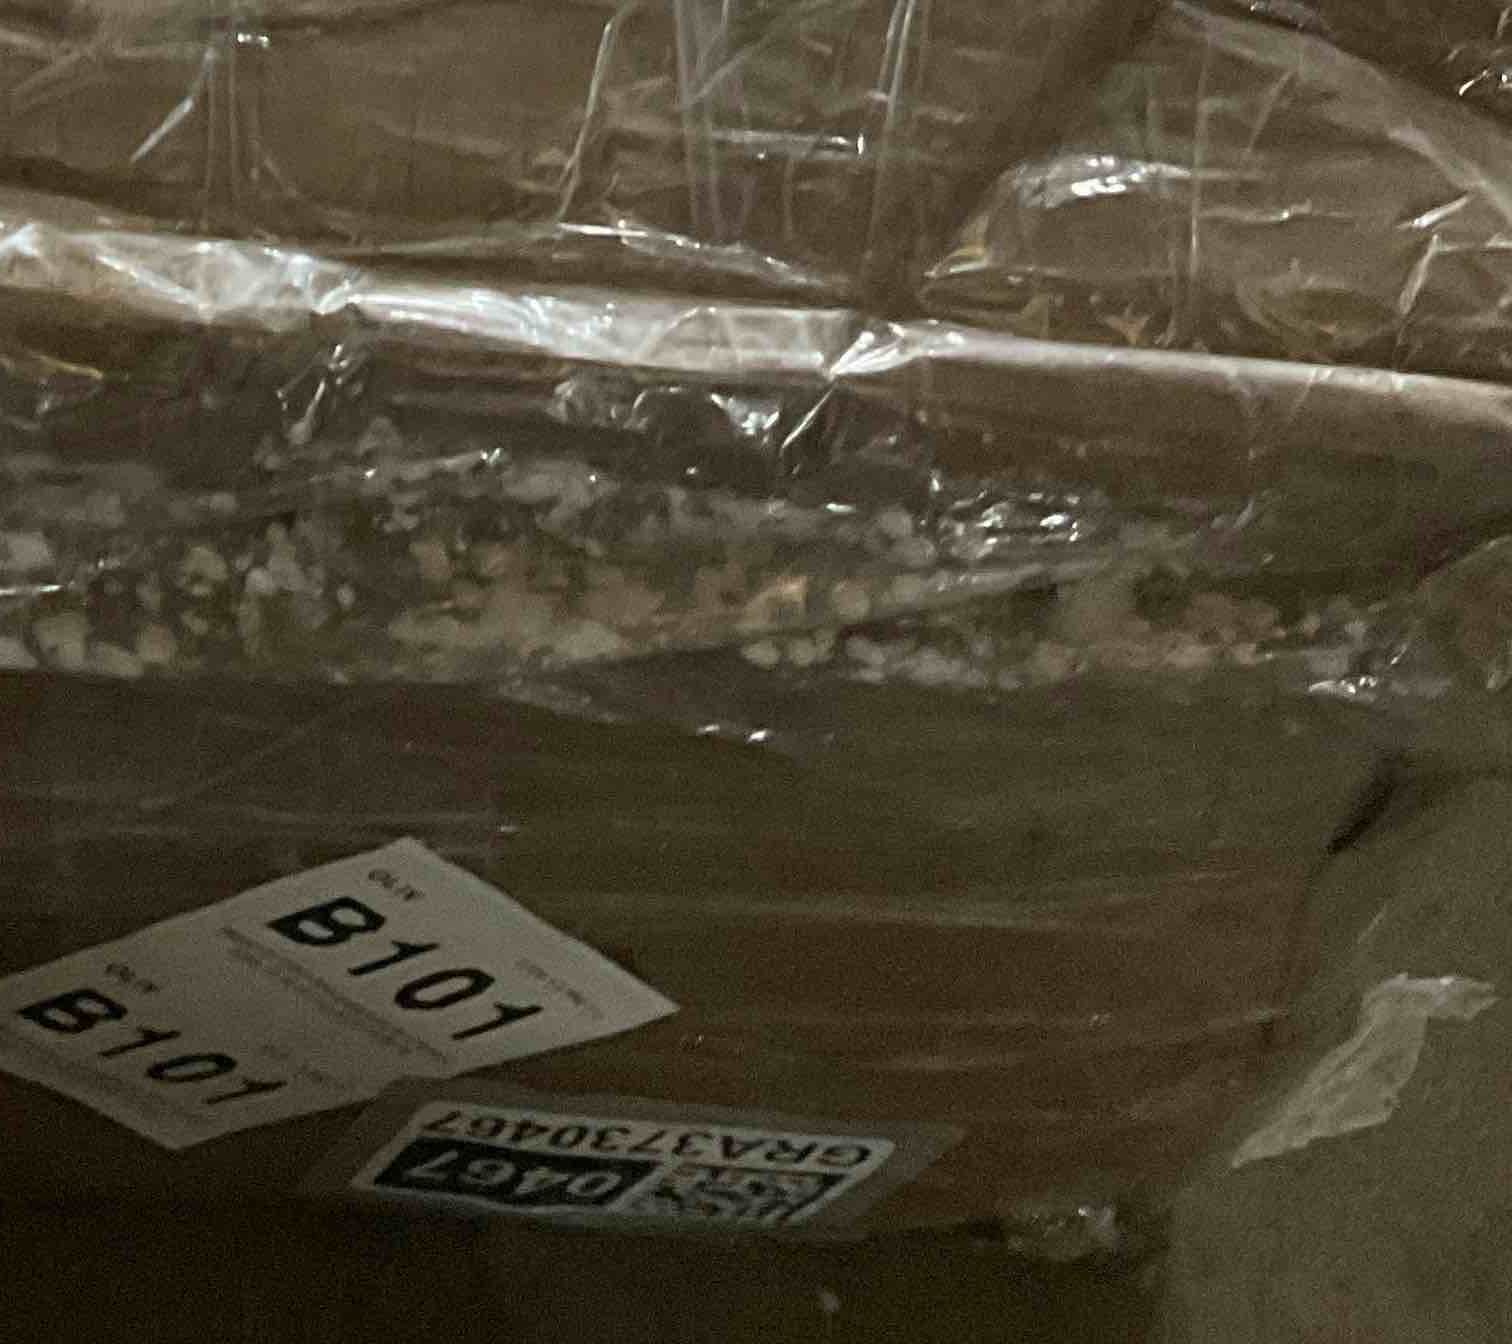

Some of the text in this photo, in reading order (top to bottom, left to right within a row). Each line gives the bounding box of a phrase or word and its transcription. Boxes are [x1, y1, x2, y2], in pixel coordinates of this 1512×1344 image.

[266, 895, 545, 1042] B101
[16, 987, 289, 1108] B101
[407, 1150, 628, 1202] 0467
